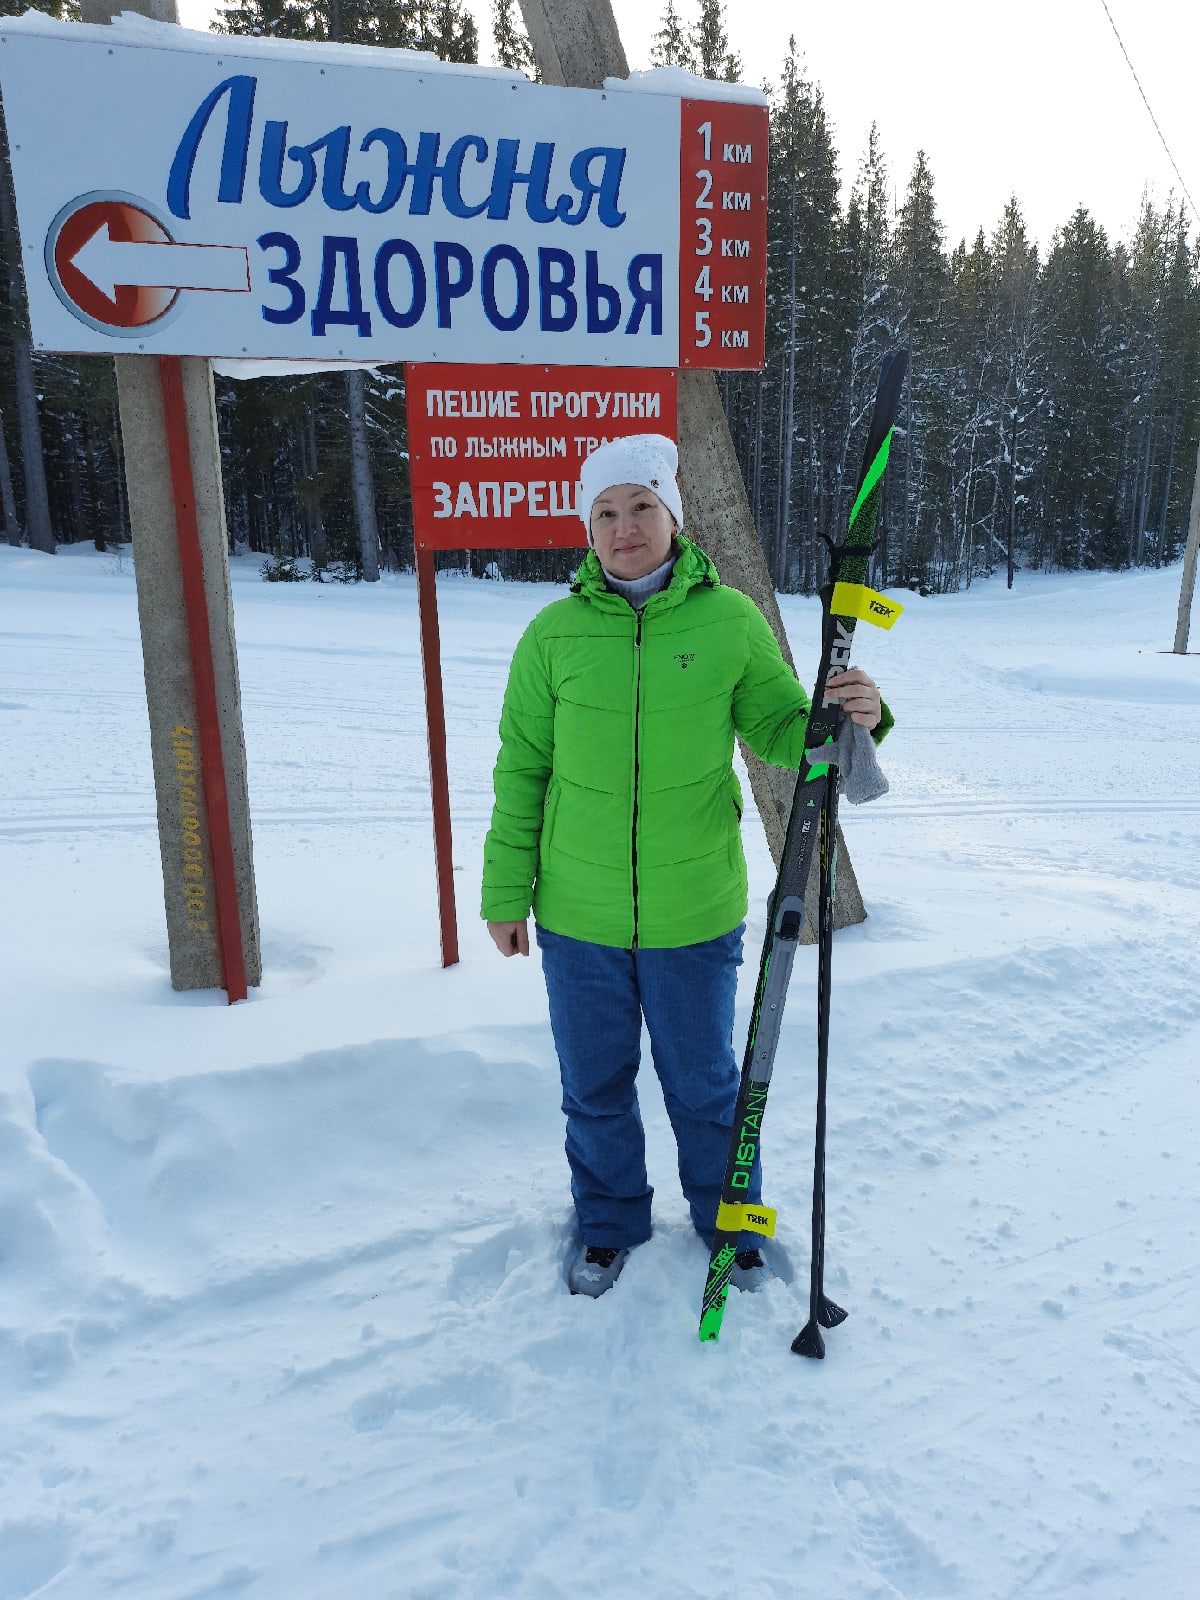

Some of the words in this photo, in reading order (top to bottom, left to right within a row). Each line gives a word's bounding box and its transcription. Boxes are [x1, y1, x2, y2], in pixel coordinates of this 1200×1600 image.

[167, 75, 627, 228] Лыжня
[697, 121, 712, 161] 1
[695, 169, 713, 210] 2
[695, 217, 713, 256] 3
[256, 231, 663, 338] ЗДОРОВЬЯ
[694, 265, 713, 302] 4
[695, 311, 712, 348] 5
[426, 389, 521, 418] ПЕШИЕ
[530, 391, 661, 418] ПРОГУЛКИ
[430, 436, 457, 458] ПО
[464, 436, 567, 458] ЛЫЖНЫМ
[432, 480, 584, 521] ЗАПРЕЩ
[868, 599, 896, 618] TREK
[731, 1080, 770, 1189] DISTANC
[745, 1213, 769, 1227] TREK
